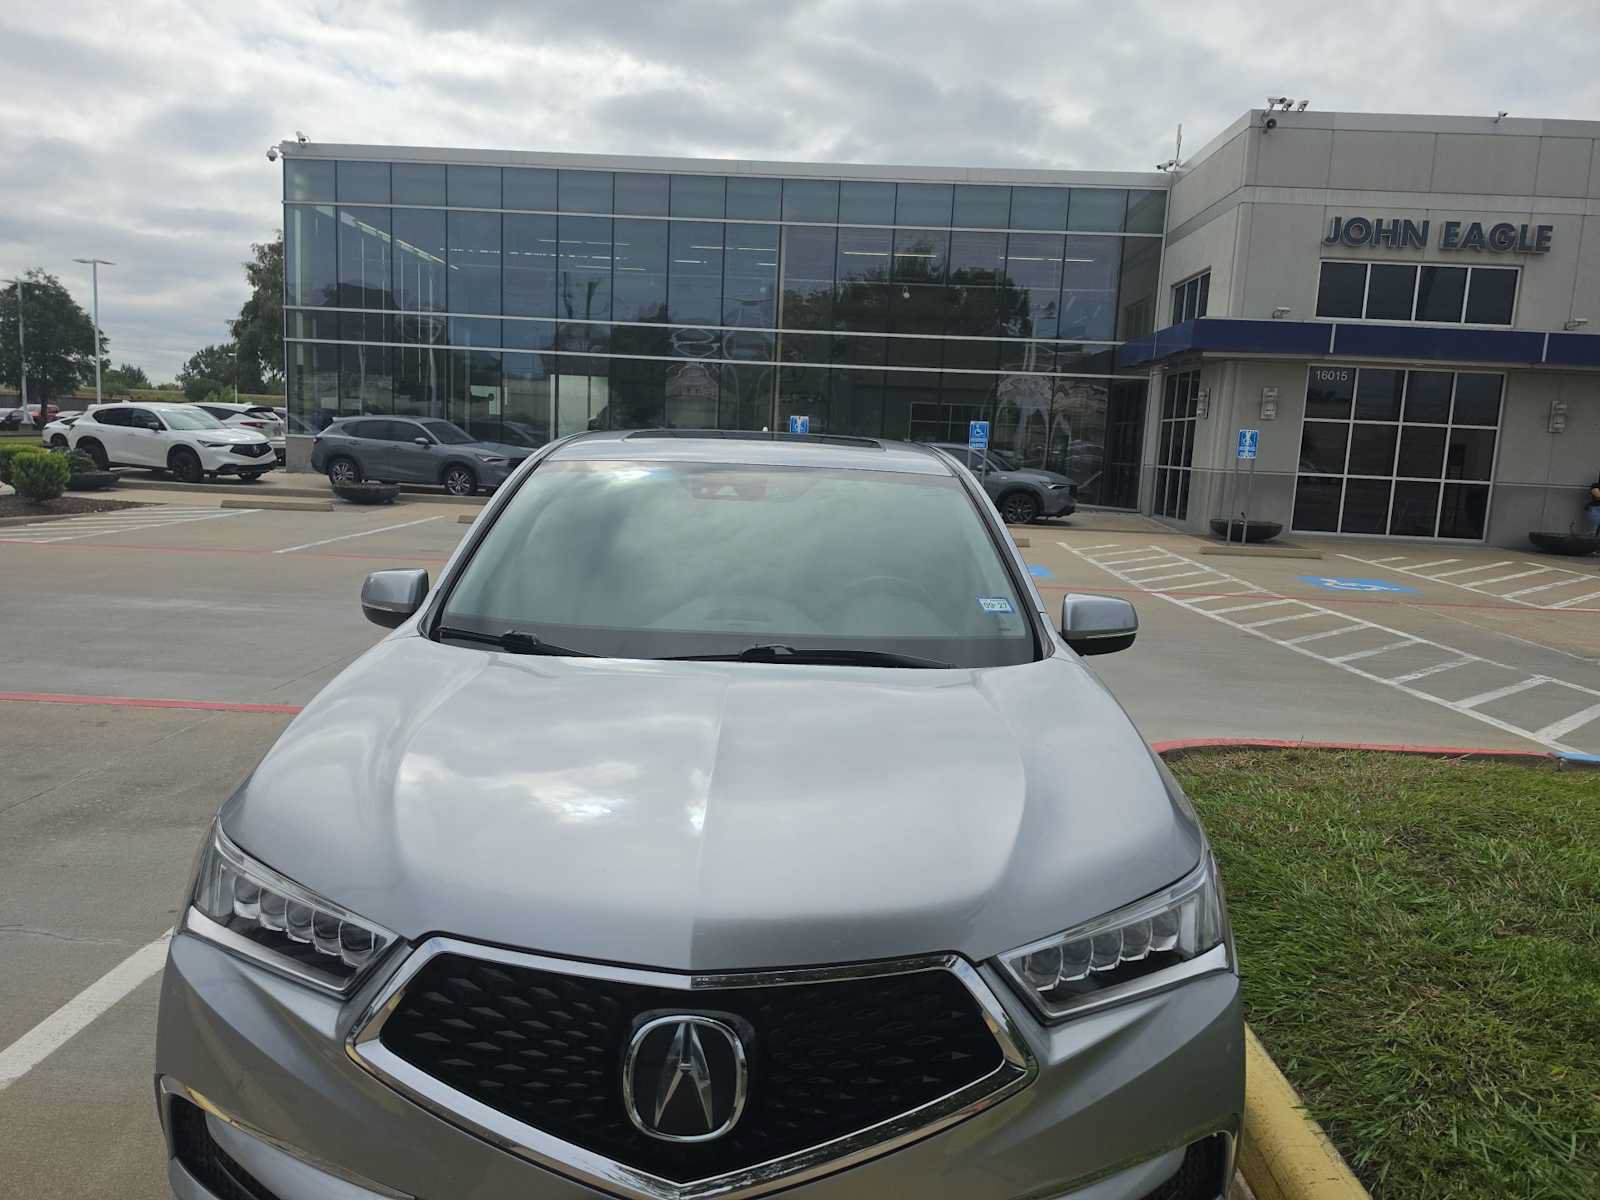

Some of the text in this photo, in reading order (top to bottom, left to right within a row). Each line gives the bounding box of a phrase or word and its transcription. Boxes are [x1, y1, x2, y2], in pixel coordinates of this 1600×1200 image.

[1324, 216, 1554, 253] JOHN EAGLE
[1316, 370, 1348, 381] 16015
